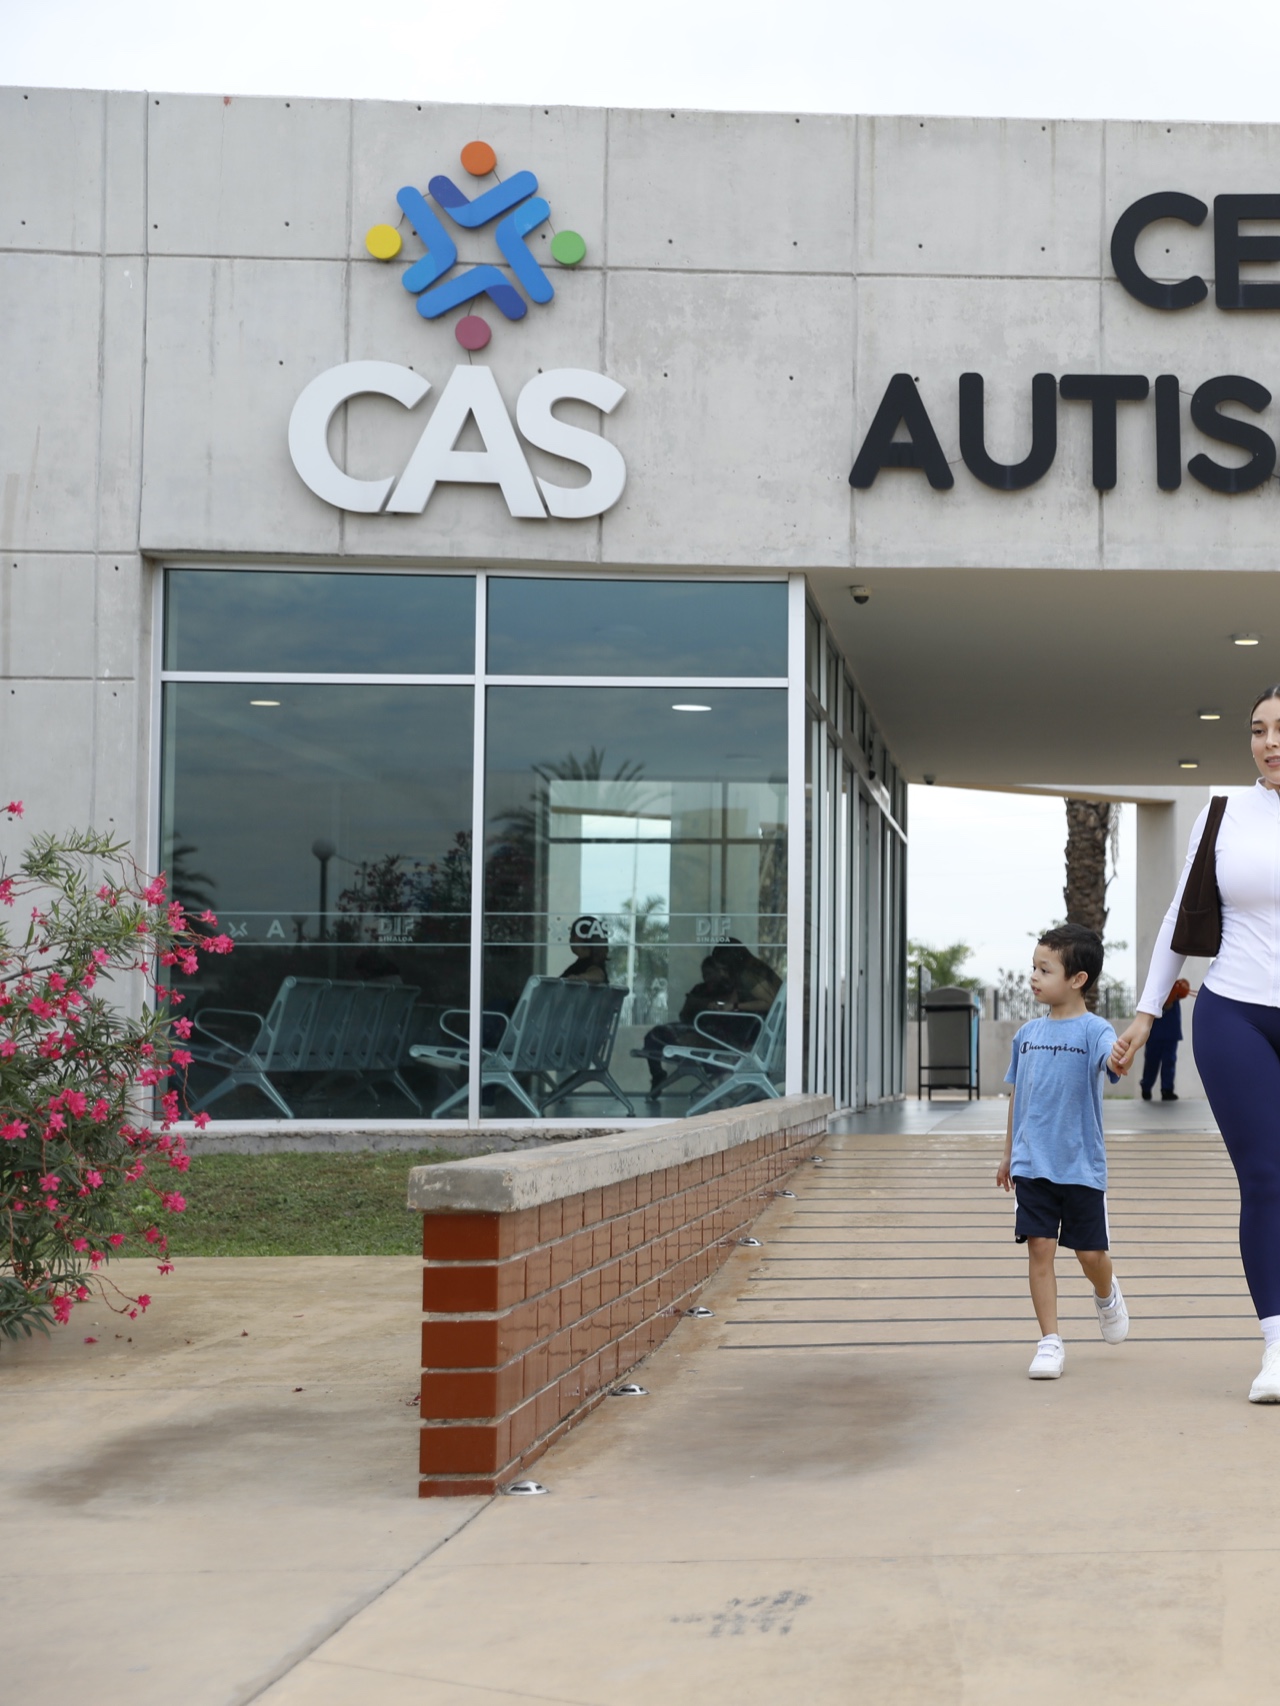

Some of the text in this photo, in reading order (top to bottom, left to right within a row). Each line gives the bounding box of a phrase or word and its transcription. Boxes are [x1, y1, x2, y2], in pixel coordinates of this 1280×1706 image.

[288, 360, 627, 519] CAS
[377, 916, 415, 935] DIF
[574, 920, 614, 939] CAS
[695, 917, 732, 936] DIF
[1020, 1041, 1087, 1056] Champion
